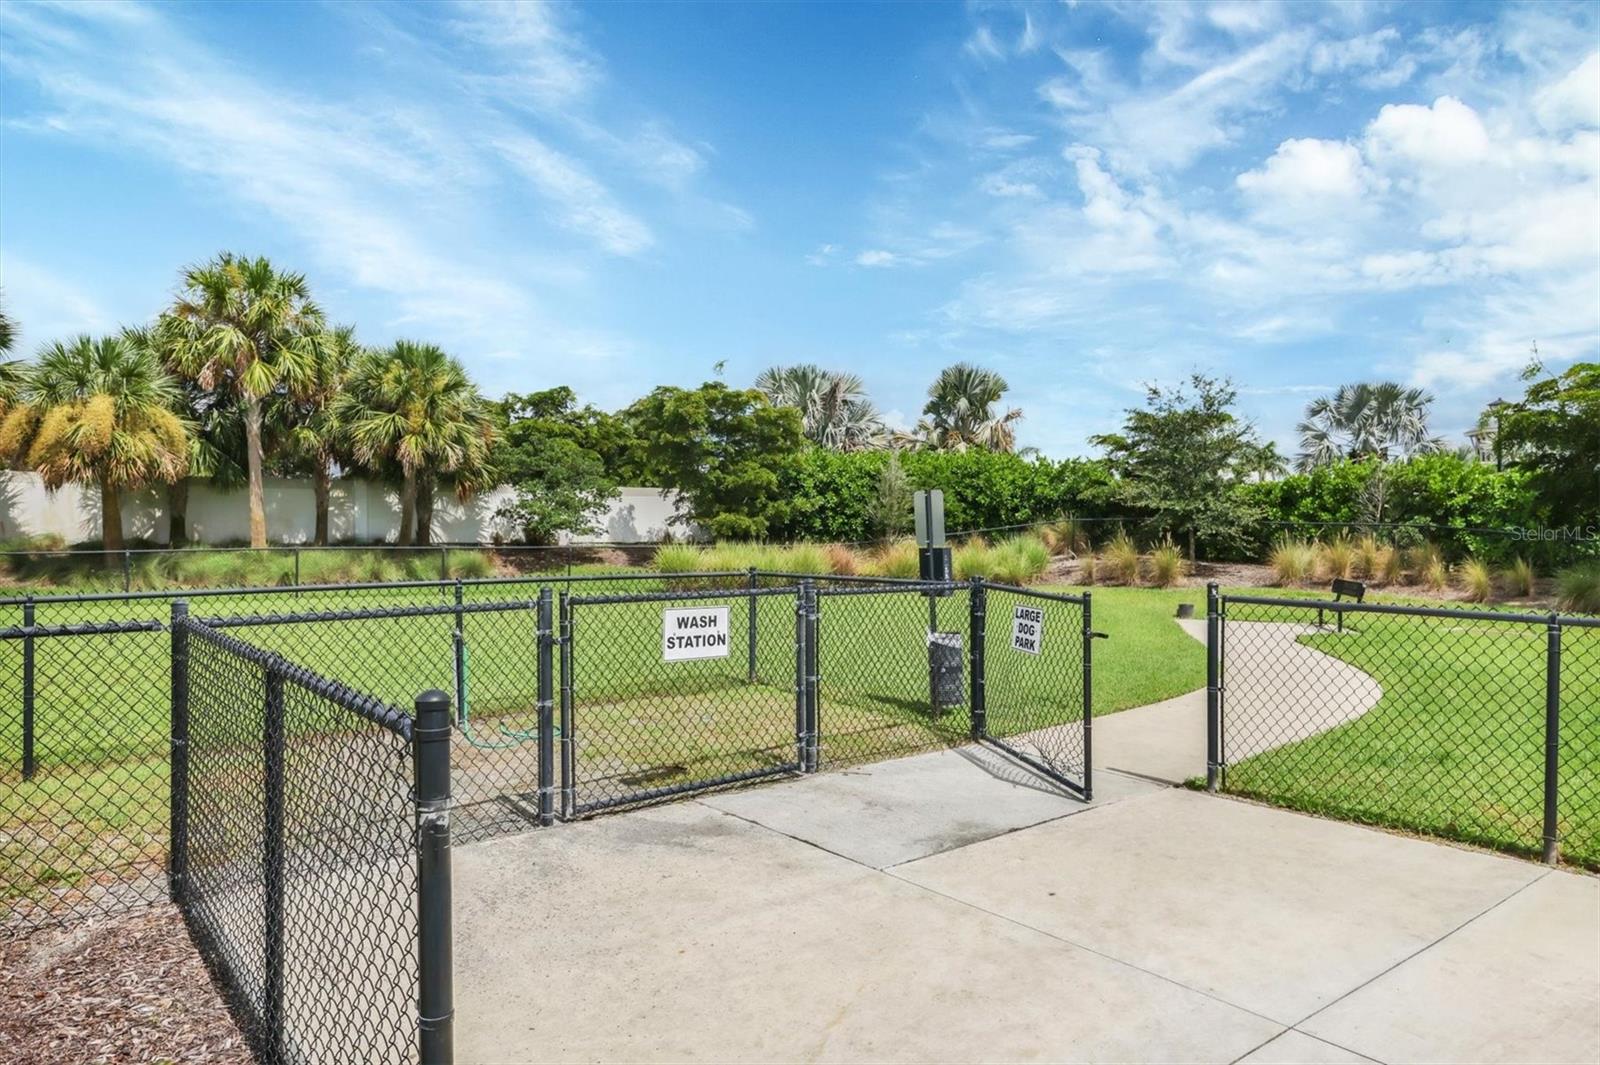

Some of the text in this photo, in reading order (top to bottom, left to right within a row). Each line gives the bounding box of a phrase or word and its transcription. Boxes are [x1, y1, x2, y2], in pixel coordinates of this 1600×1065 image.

[676, 615, 718, 629] WASH
[1015, 607, 1041, 623] LARGE
[1018, 622, 1035, 636] DOG
[666, 633, 726, 650] STATION
[1014, 635, 1036, 651] PARK
